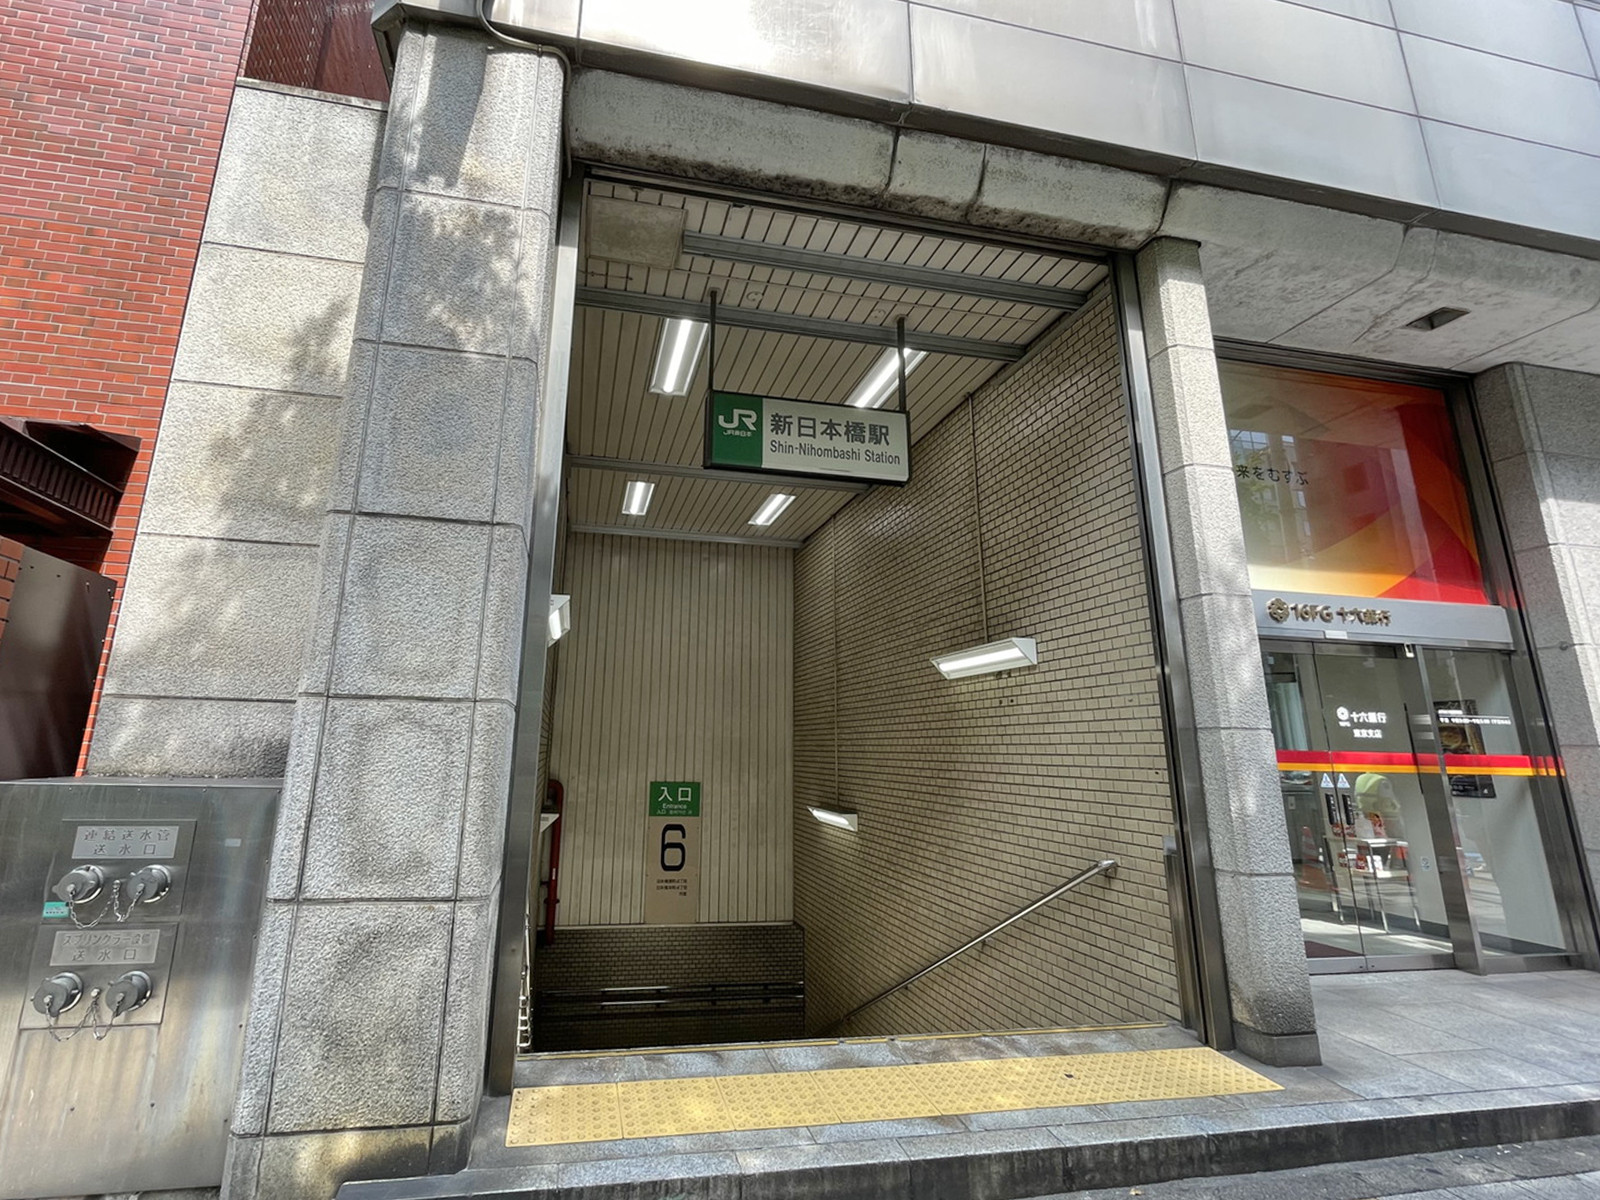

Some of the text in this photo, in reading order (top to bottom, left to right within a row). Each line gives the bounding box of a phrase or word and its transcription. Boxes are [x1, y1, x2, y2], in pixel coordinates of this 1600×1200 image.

[718, 408, 758, 431] JR
[770, 412, 890, 446] 新日本橋駅
[770, 439, 900, 465] Shin-Nihombashi Station
[658, 786, 692, 801] 入口
[93, 843, 157, 856] 送水口
[660, 823, 686, 872] 6
[71, 948, 138, 962] 送水口
